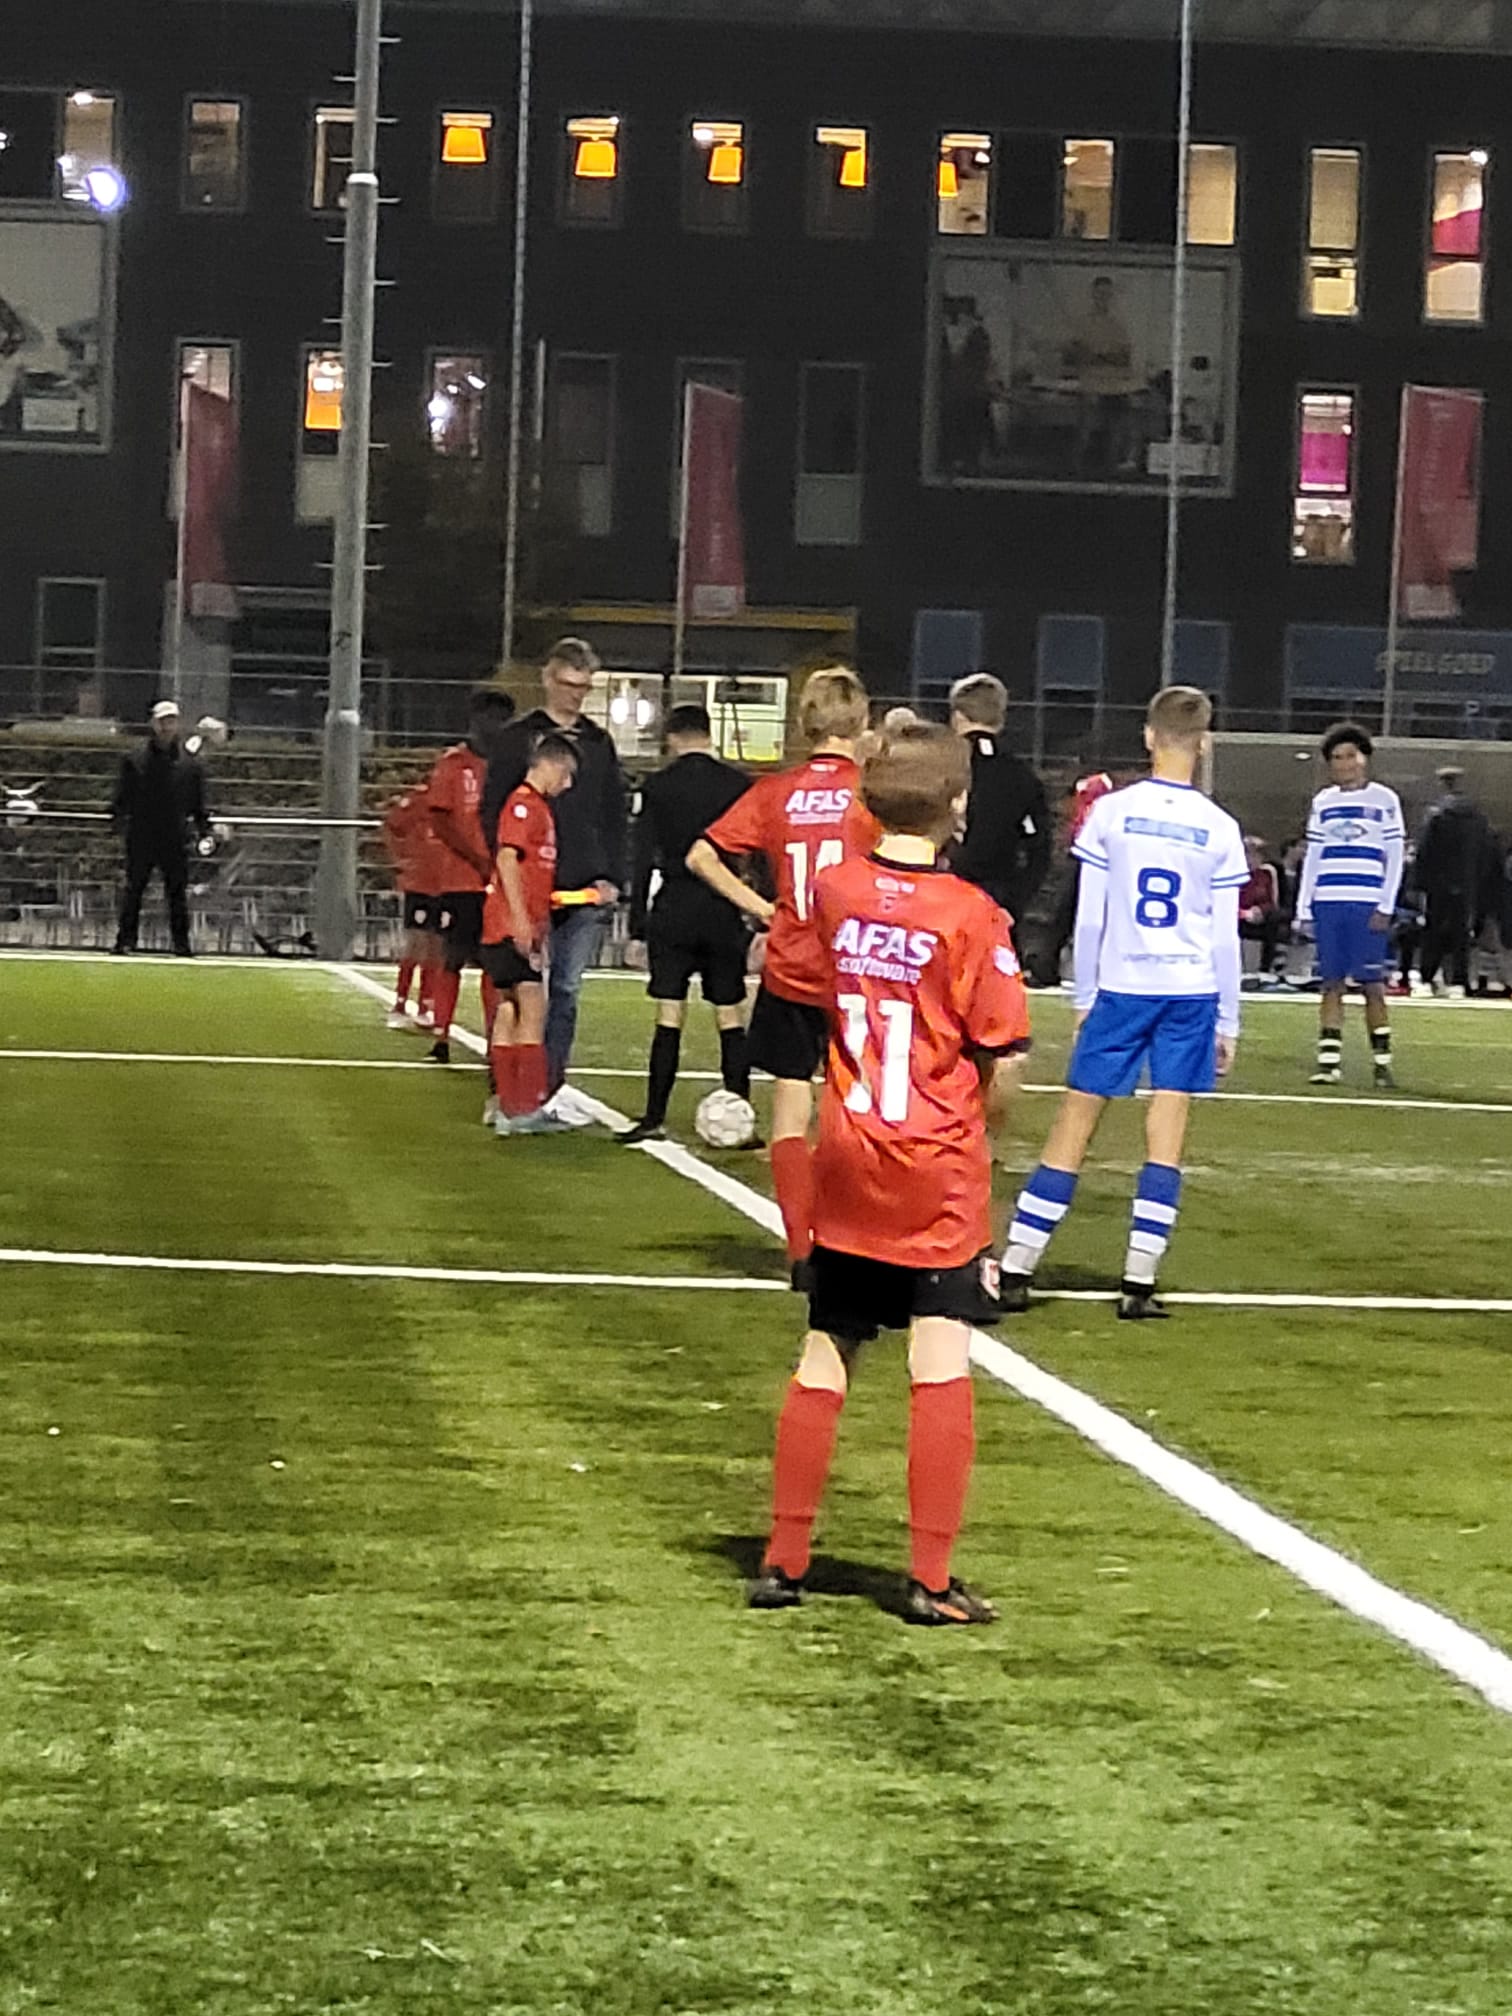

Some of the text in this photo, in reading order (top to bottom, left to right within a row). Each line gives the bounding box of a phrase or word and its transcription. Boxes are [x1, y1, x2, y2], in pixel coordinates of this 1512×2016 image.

[785, 789, 851, 812] AFAS
[1136, 867, 1182, 928] 8
[833, 918, 938, 966] AFAS
[837, 994, 914, 1122] 11
